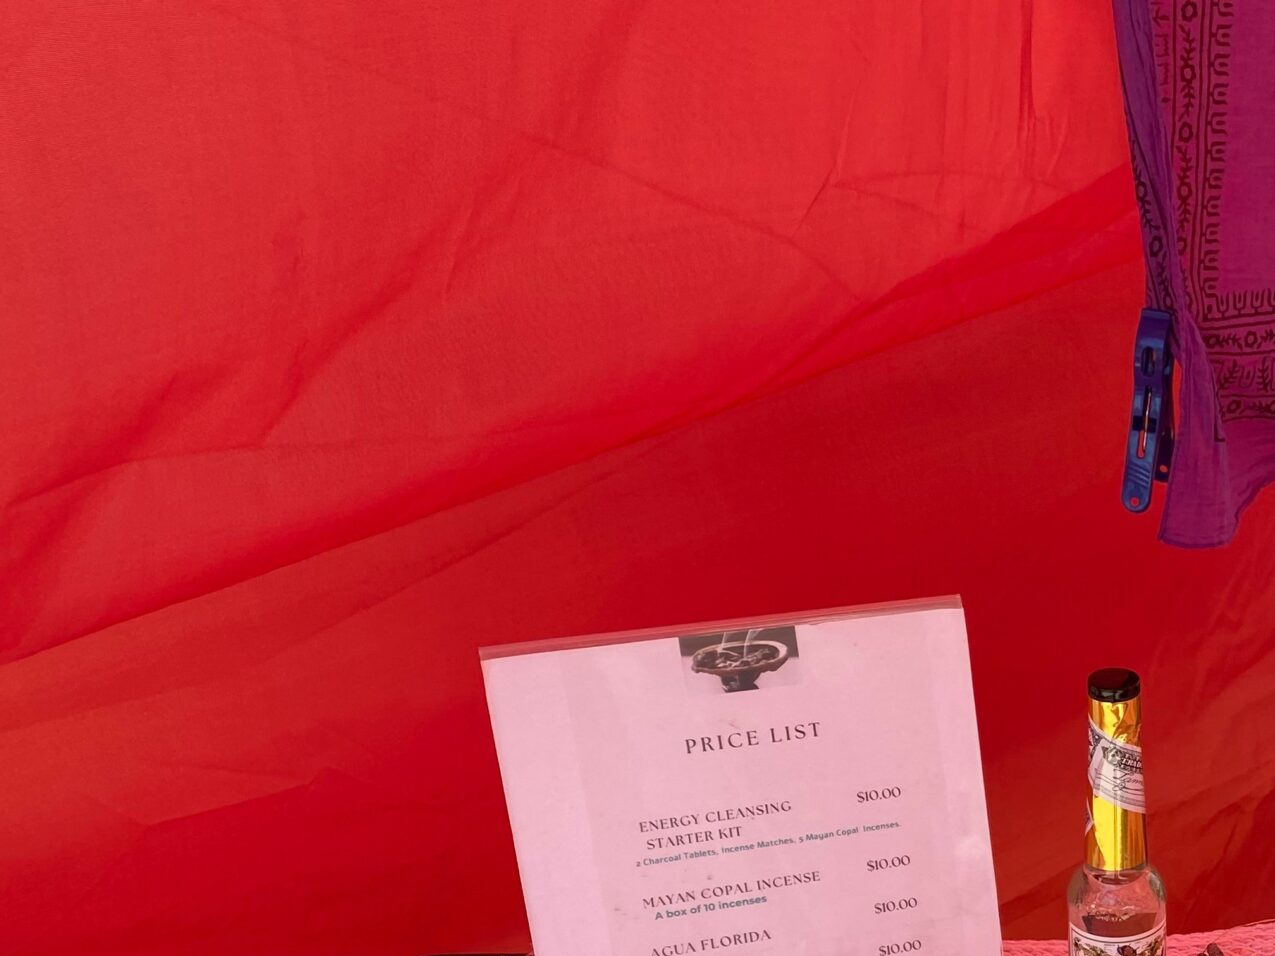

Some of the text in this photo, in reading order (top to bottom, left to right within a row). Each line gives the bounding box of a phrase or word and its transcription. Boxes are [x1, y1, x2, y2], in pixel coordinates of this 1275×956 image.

[685, 721, 822, 754] PRICE LIST
[856, 786, 902, 804] $10.00
[639, 800, 793, 834] ENERGY CLEANSING
[643, 852, 682, 866] Charcoal
[721, 842, 755, 855] Incense
[805, 830, 835, 844] Mayan
[835, 826, 860, 840] Copal
[646, 825, 743, 851] STARTER KIT
[866, 854, 912, 873] $10.00
[642, 871, 821, 910] MAYAN COPAL INCENSE
[655, 895, 768, 921] A box of 10 incenses
[874, 897, 918, 914] $10.00
[700, 929, 772, 951] FLORIDA
[878, 939, 922, 956] $10.00
